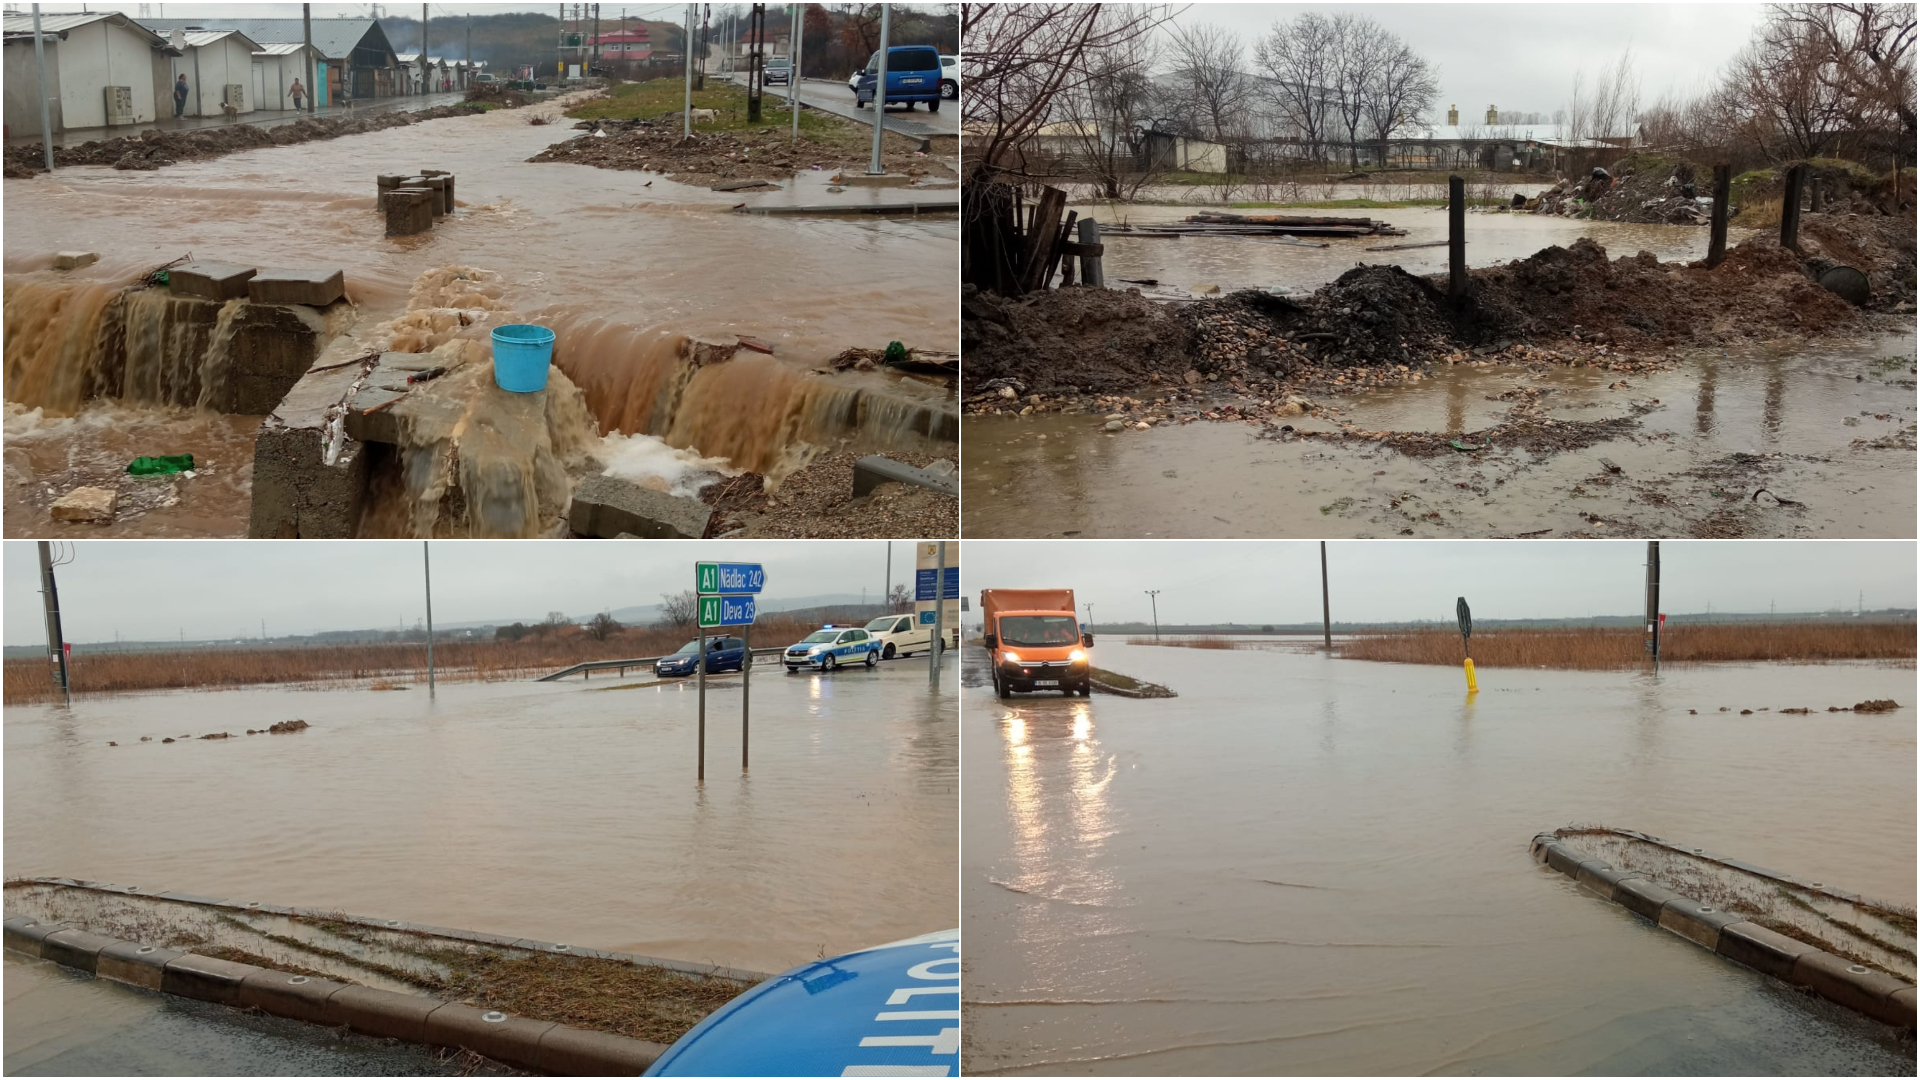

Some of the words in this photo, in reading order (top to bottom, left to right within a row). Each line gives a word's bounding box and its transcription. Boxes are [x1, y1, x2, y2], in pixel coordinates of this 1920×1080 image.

[702, 568, 715, 589] A1
[749, 570, 762, 588] 242
[704, 600, 717, 622] A1
[724, 600, 743, 620] Deva
[745, 602, 754, 619] 29
